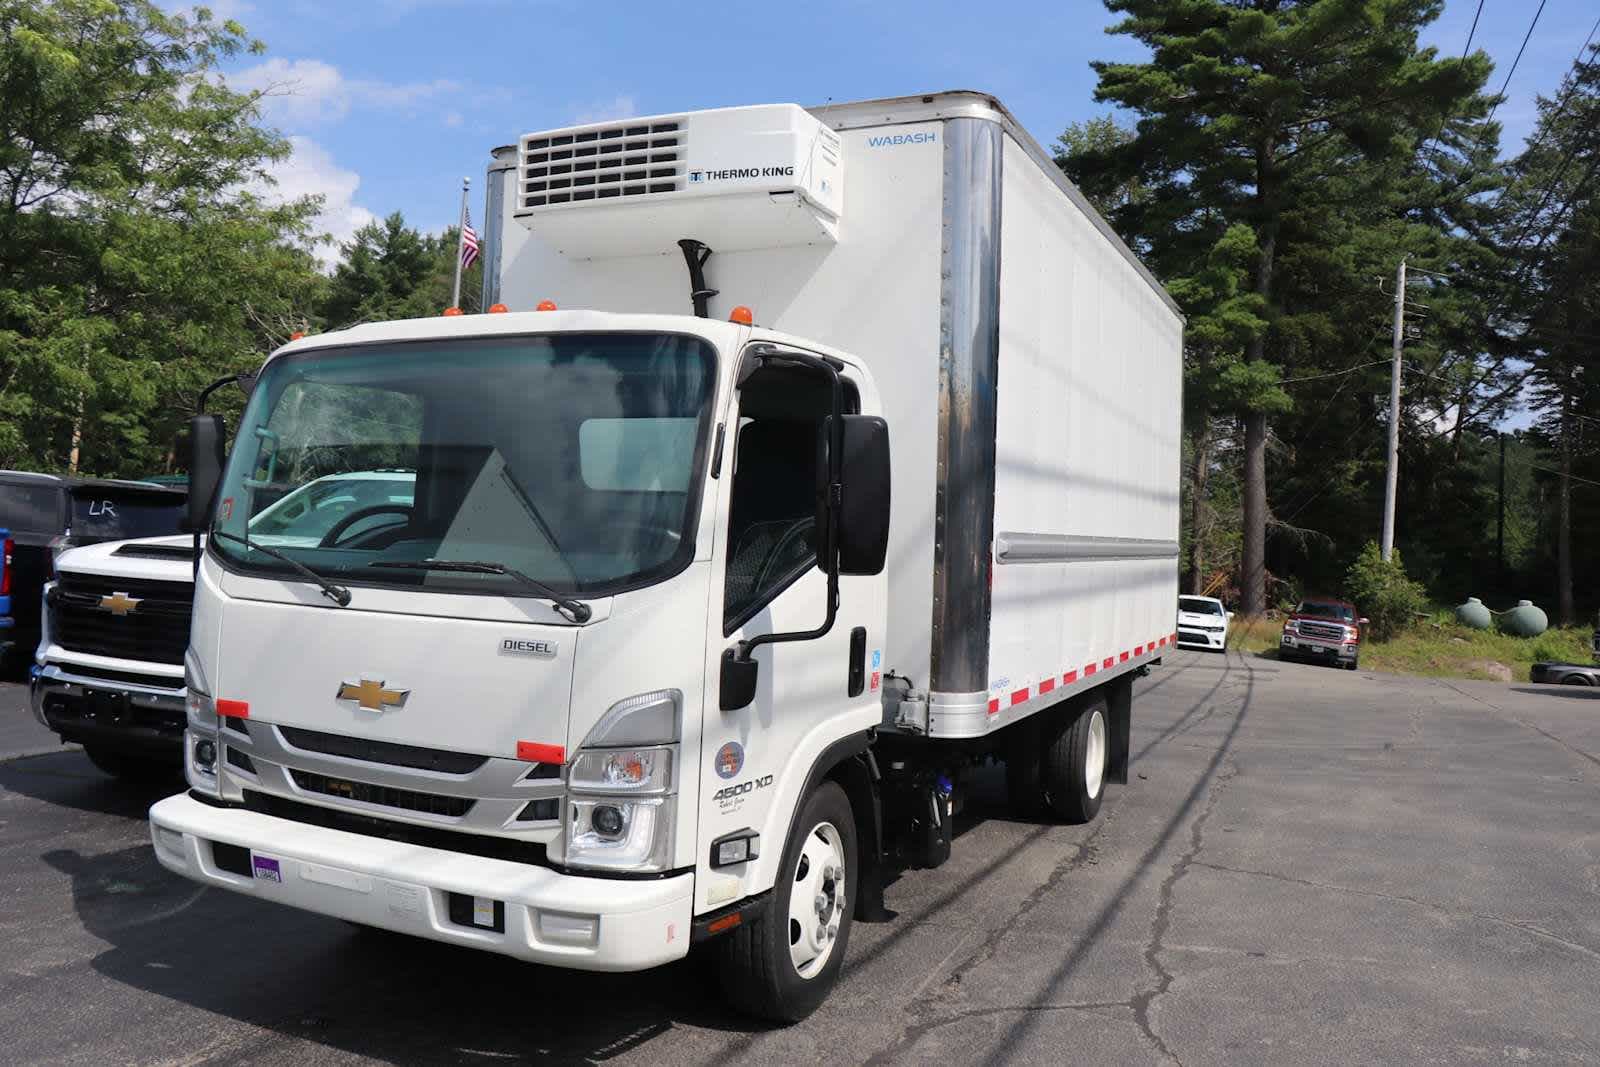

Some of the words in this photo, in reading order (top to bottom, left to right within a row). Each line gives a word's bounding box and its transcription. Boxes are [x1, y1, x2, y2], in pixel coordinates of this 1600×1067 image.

[868, 132, 936, 147] WABASH
[705, 168, 759, 180] THERMO
[762, 166, 794, 178] KING
[89, 500, 116, 517] LR
[504, 640, 552, 653] DIESEL
[713, 781, 753, 801] 4500
[755, 774, 774, 789] XD
